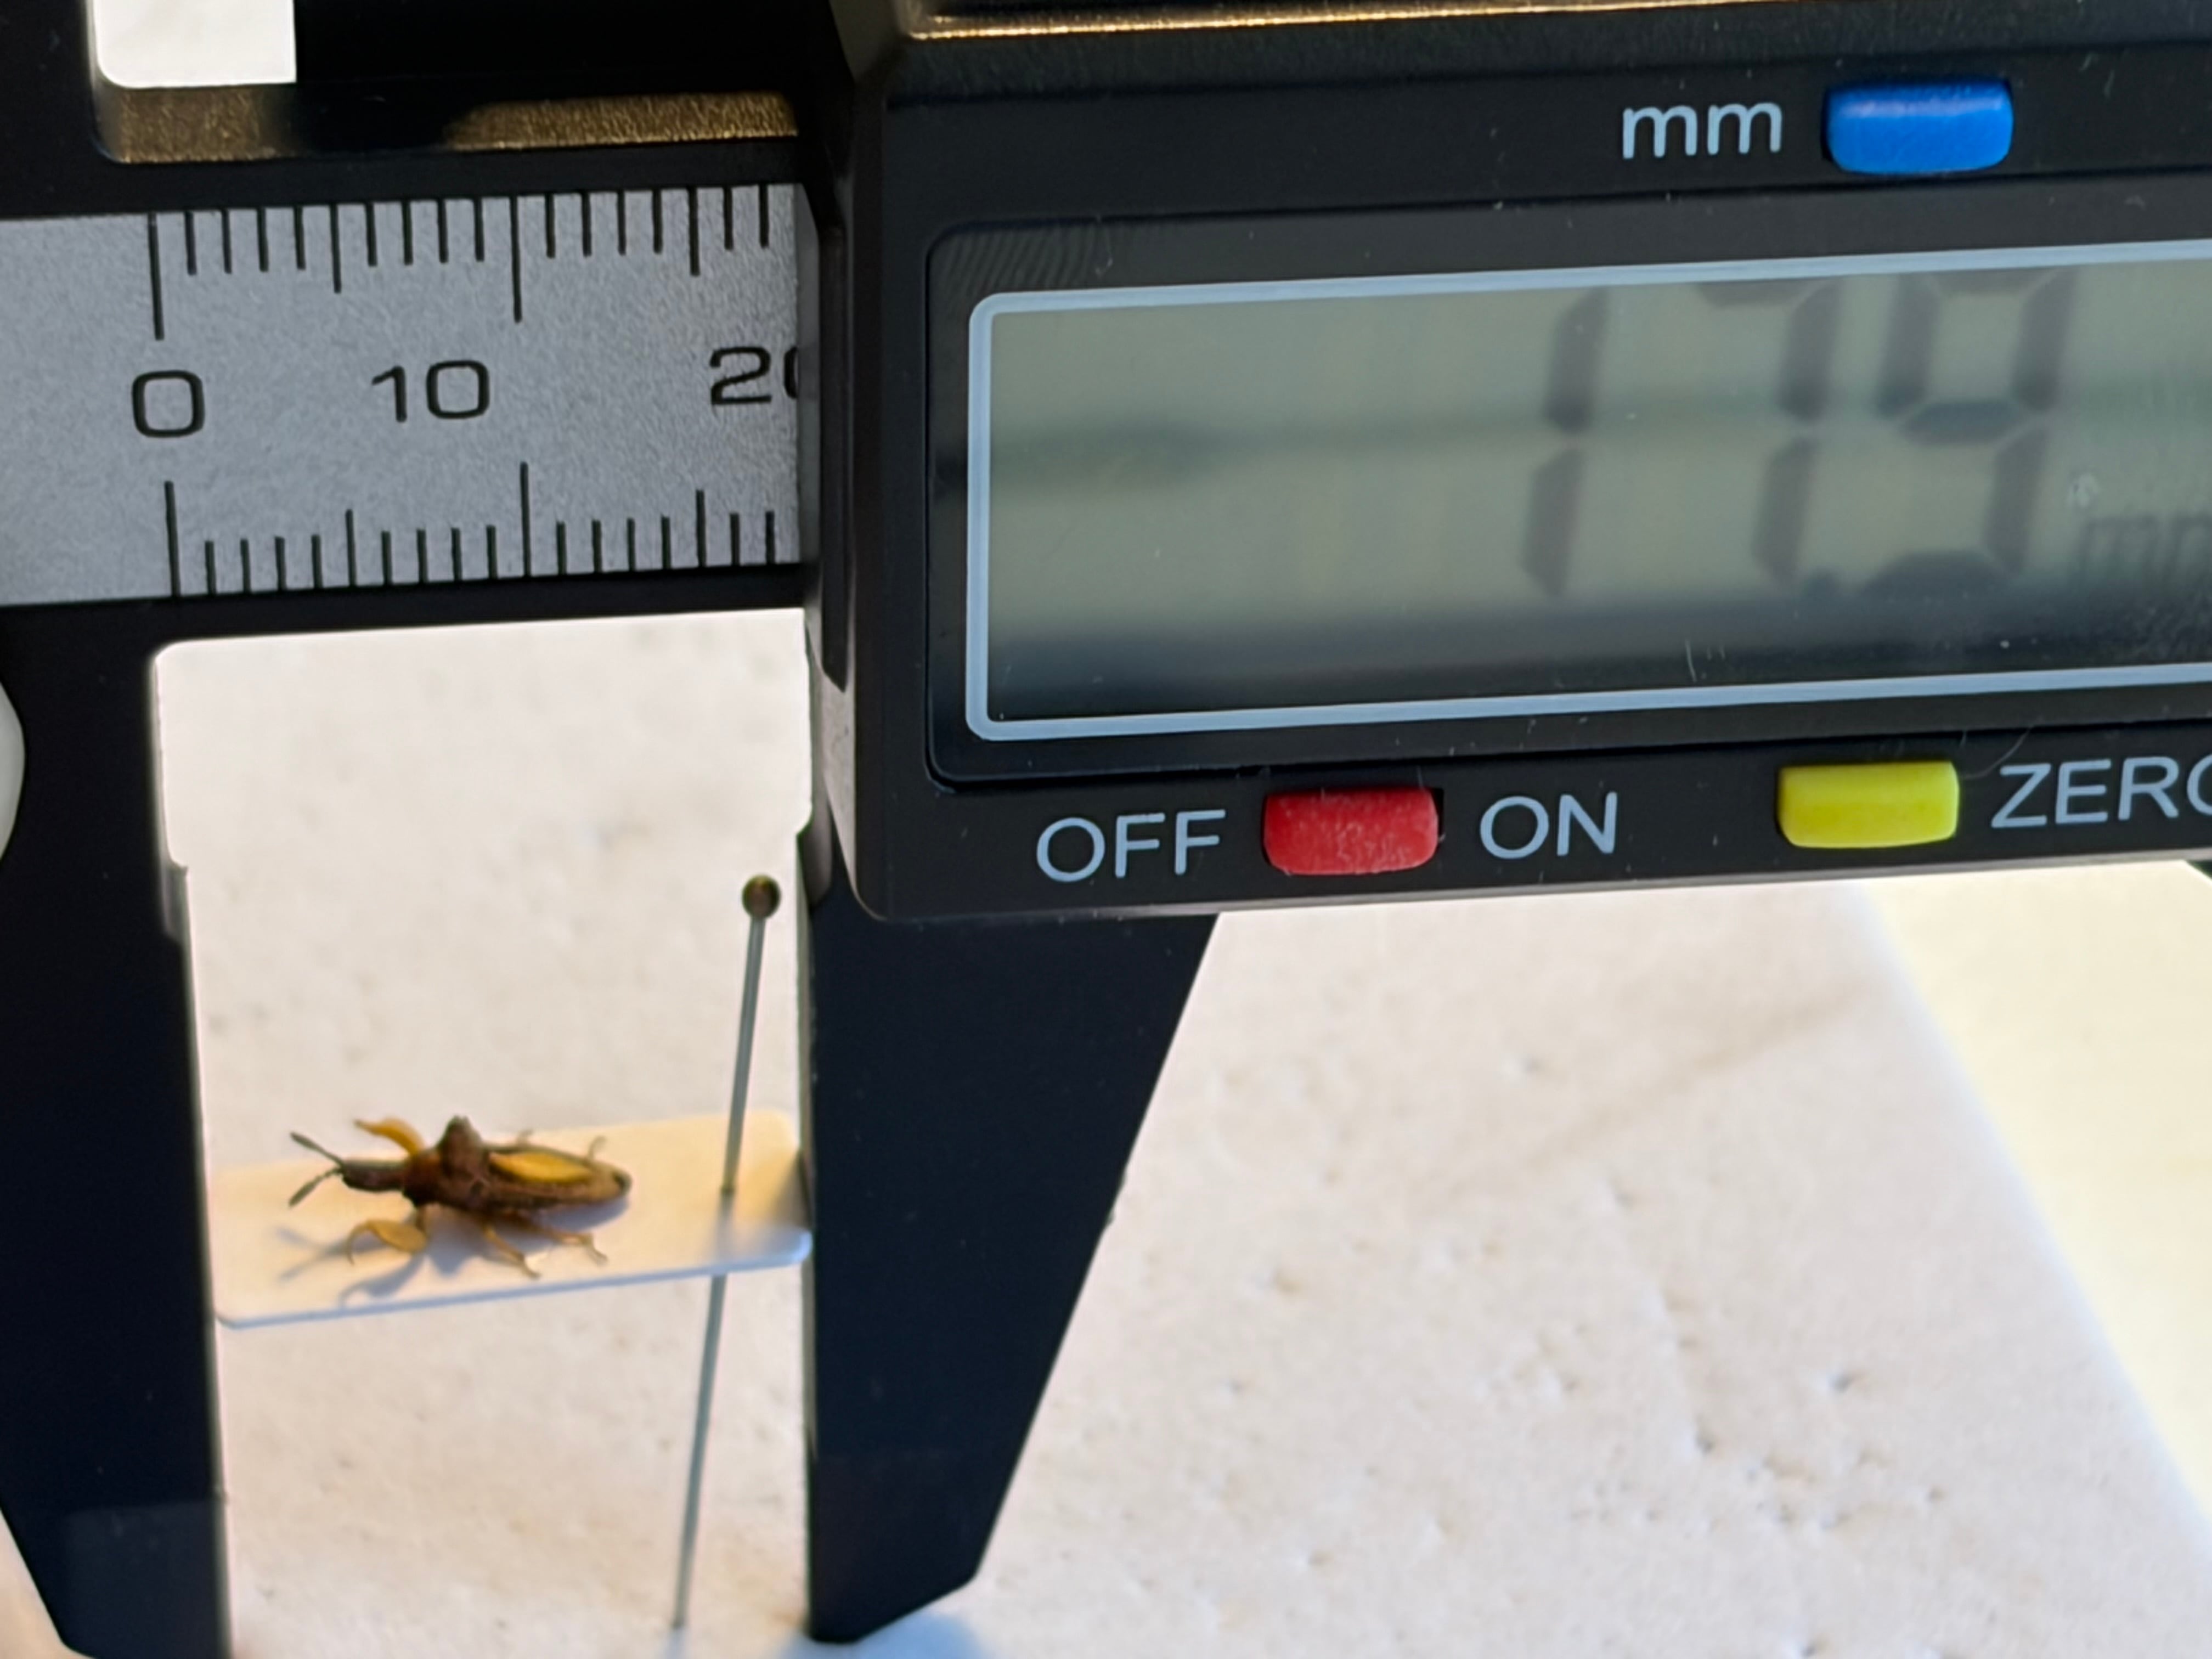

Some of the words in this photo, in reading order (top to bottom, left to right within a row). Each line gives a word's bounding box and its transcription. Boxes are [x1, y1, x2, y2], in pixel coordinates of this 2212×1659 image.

[1622, 101, 1782, 159] mm
[131, 370, 205, 438] 0
[371, 359, 490, 422] 10
[710, 346, 797, 405] 2
[1036, 809, 1226, 882] OFF
[1480, 791, 1617, 860] ON
